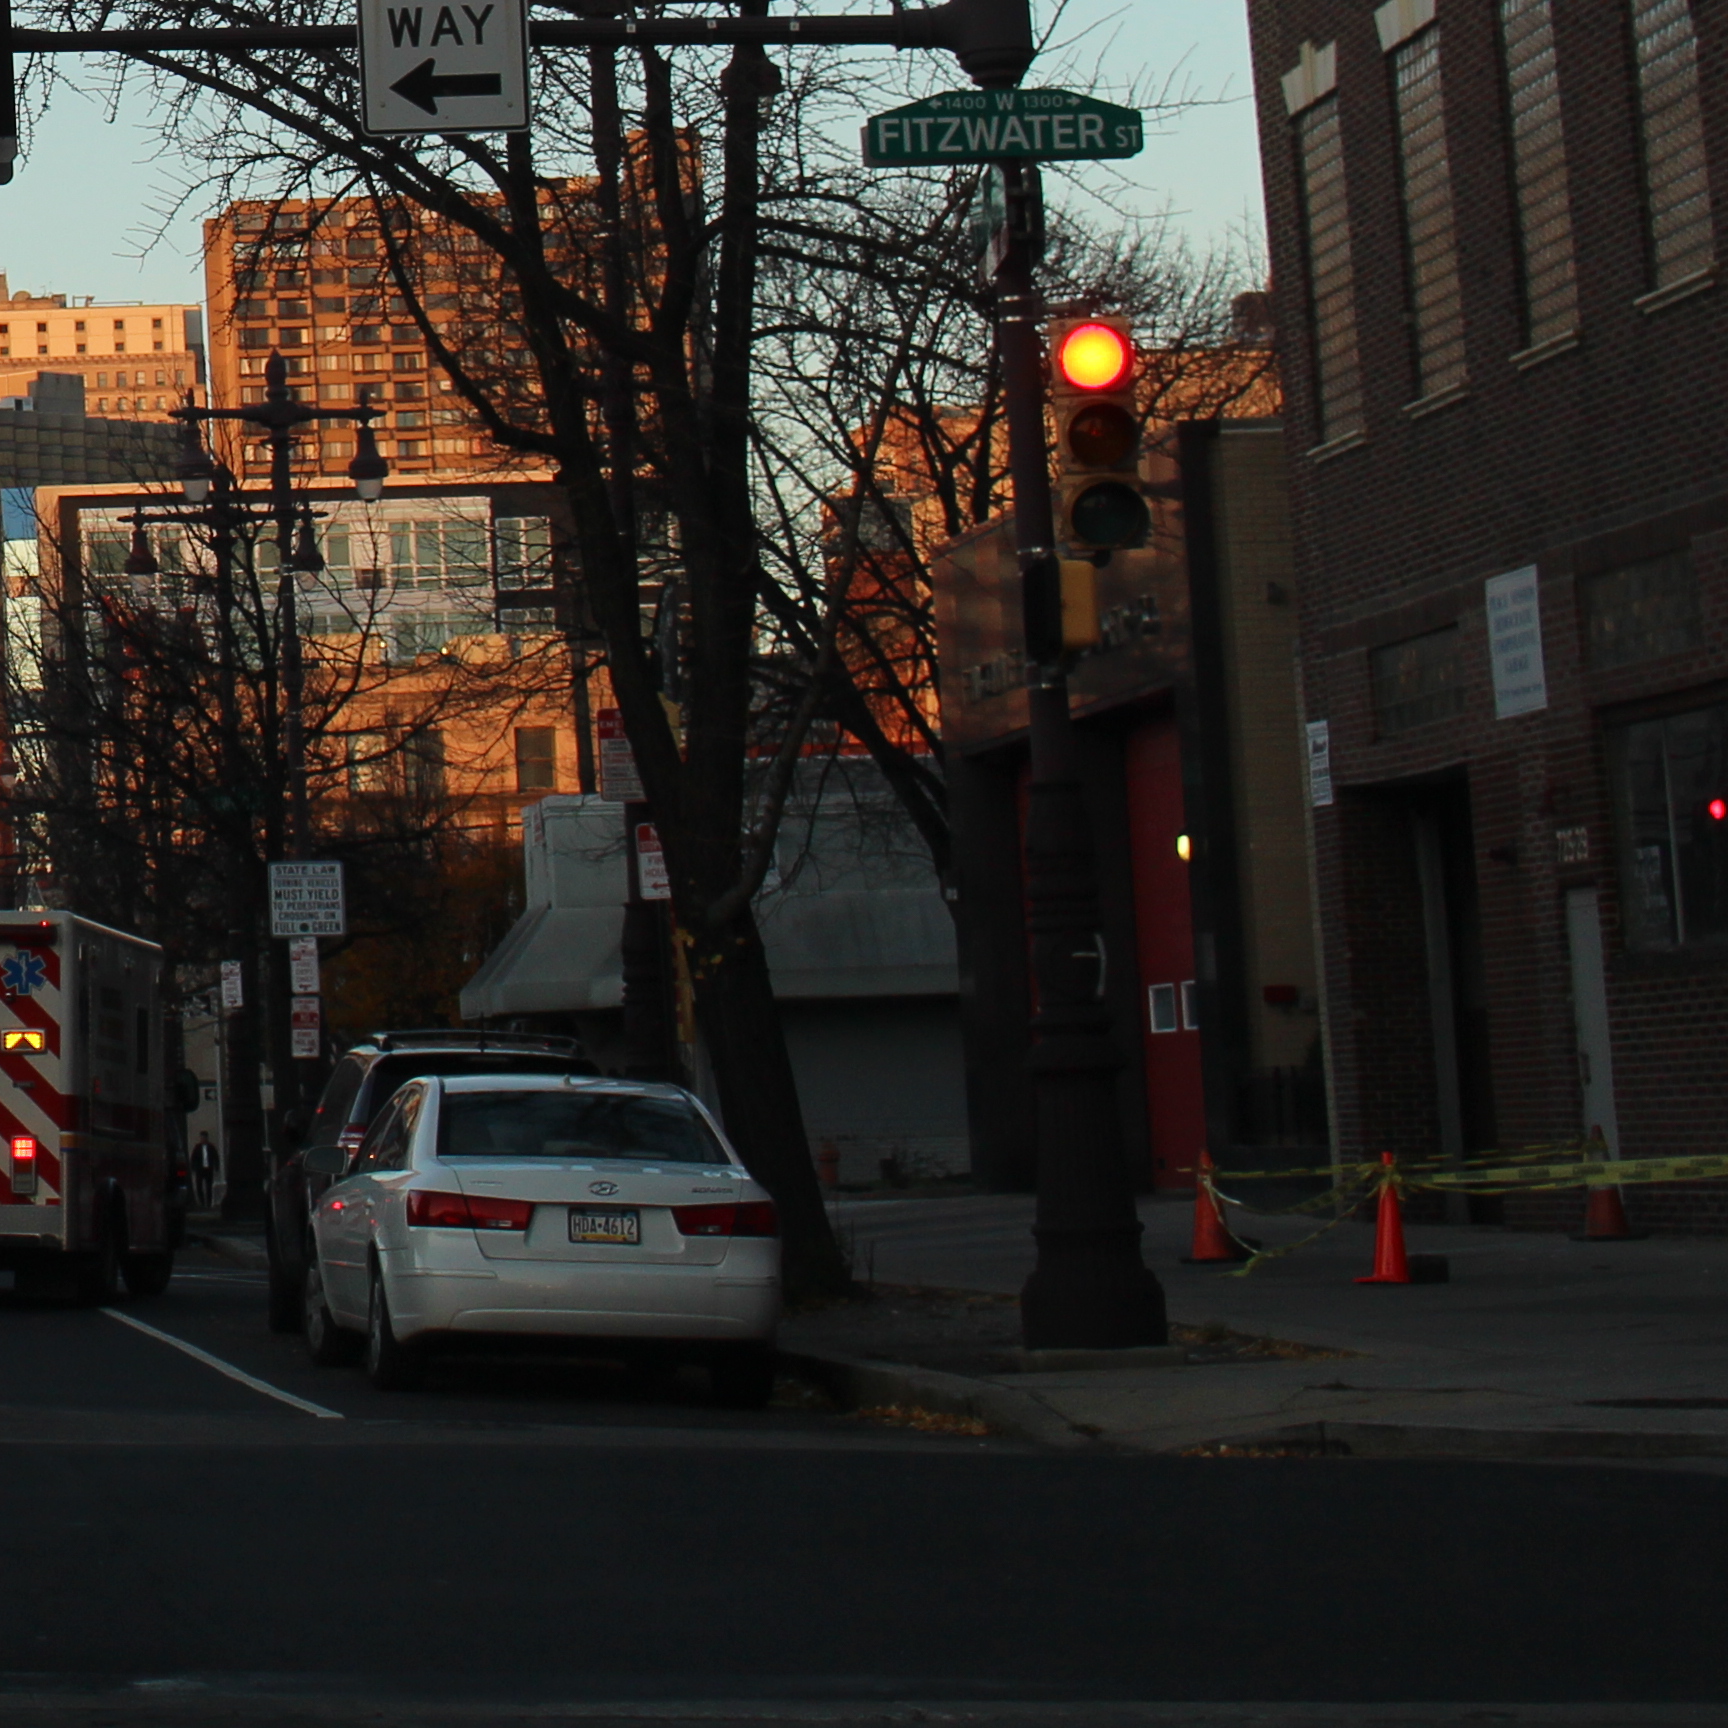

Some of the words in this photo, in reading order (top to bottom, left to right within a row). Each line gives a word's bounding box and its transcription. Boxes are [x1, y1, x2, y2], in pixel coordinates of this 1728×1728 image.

[387, 3, 495, 49] WAY
[945, 96, 987, 110] 1400
[995, 92, 1015, 111] W
[1023, 94, 1063, 109] 1300
[877, 113, 1107, 154] FITZWATER
[1114, 124, 1140, 149] ST
[275, 865, 308, 874] STATE
[312, 865, 336, 874] LAW
[275, 888, 302, 901] MUST
[307, 888, 339, 901] YIELD
[275, 922, 296, 933] FULL
[312, 922, 341, 933] GREEN
